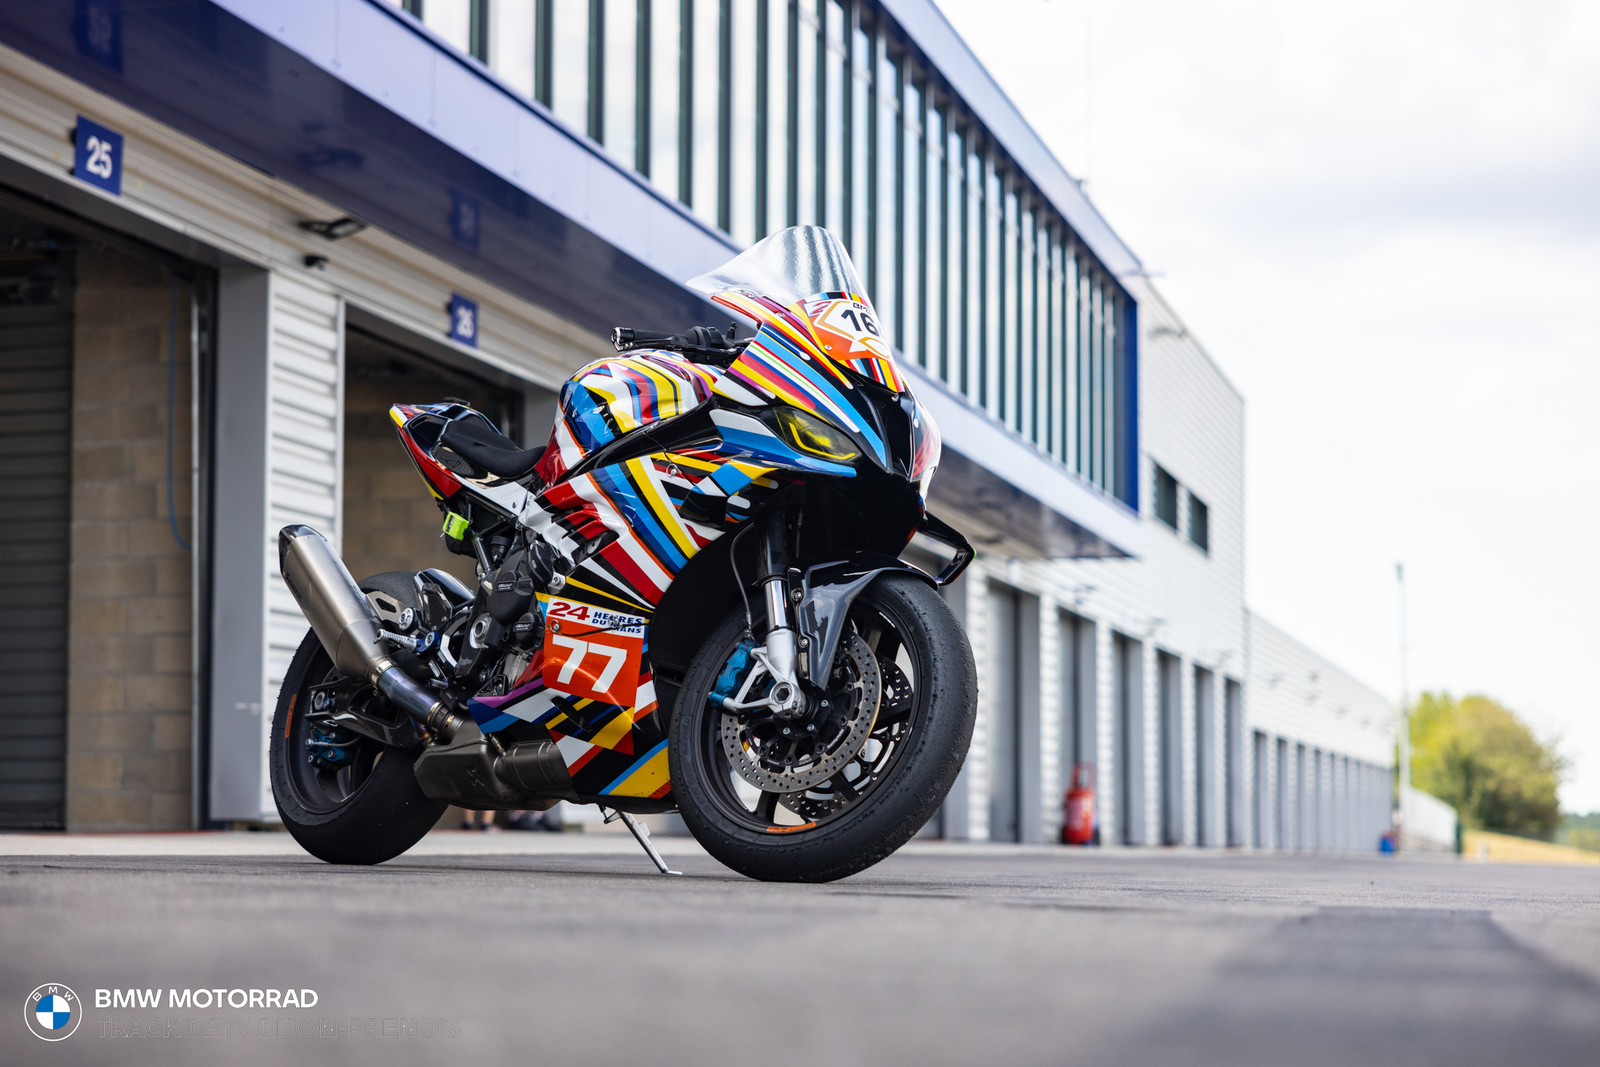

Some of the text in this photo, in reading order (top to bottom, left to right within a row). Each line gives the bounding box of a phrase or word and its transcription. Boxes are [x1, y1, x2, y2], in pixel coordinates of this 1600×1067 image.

[86, 135, 113, 179] 25
[841, 309, 880, 338] 16
[547, 601, 591, 621] 24
[591, 618, 607, 626] DU
[552, 634, 628, 694] 77
